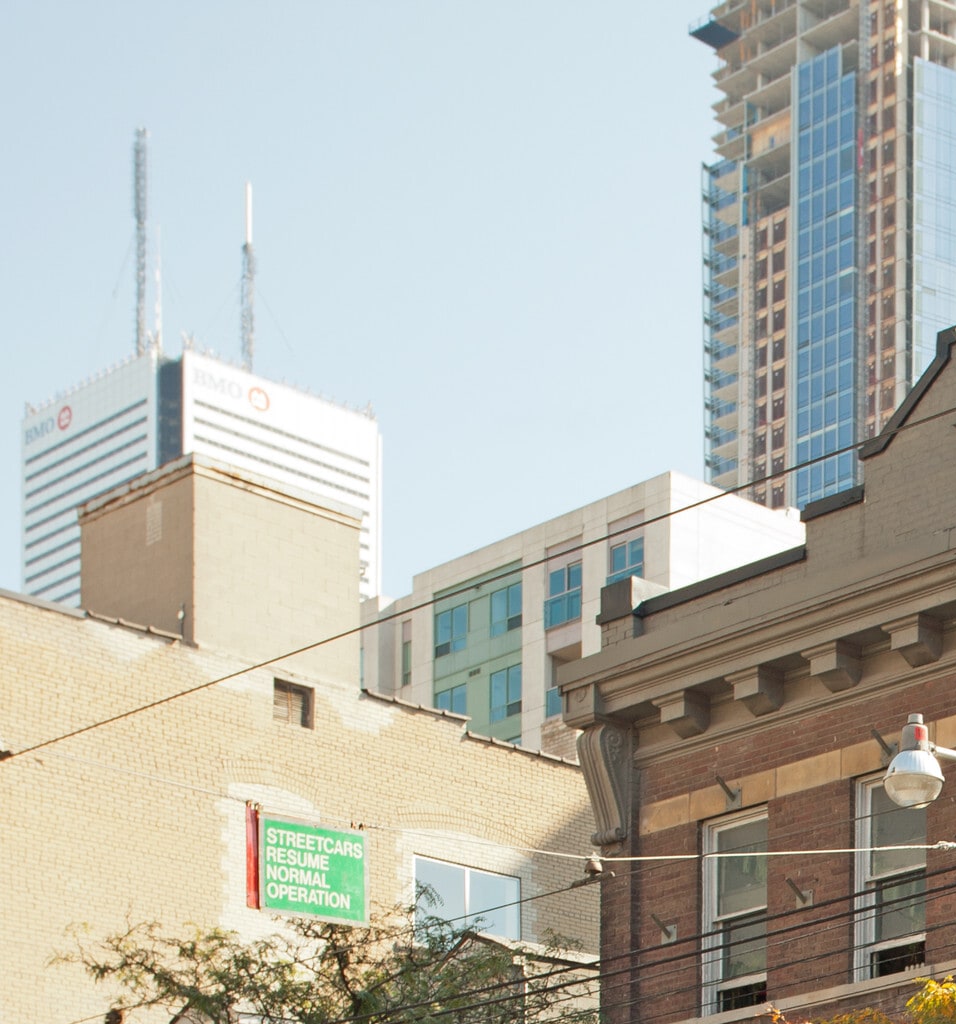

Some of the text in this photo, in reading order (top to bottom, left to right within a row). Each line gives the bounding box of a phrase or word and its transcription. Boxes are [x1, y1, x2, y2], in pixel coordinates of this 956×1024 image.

[192, 367, 242, 399] BMO
[24, 417, 55, 445] BMO
[266, 827, 363, 859] STREETCARS
[266, 846, 330, 871] RESUME
[266, 864, 331, 889] NORMAL
[266, 882, 351, 909] OPERATION
